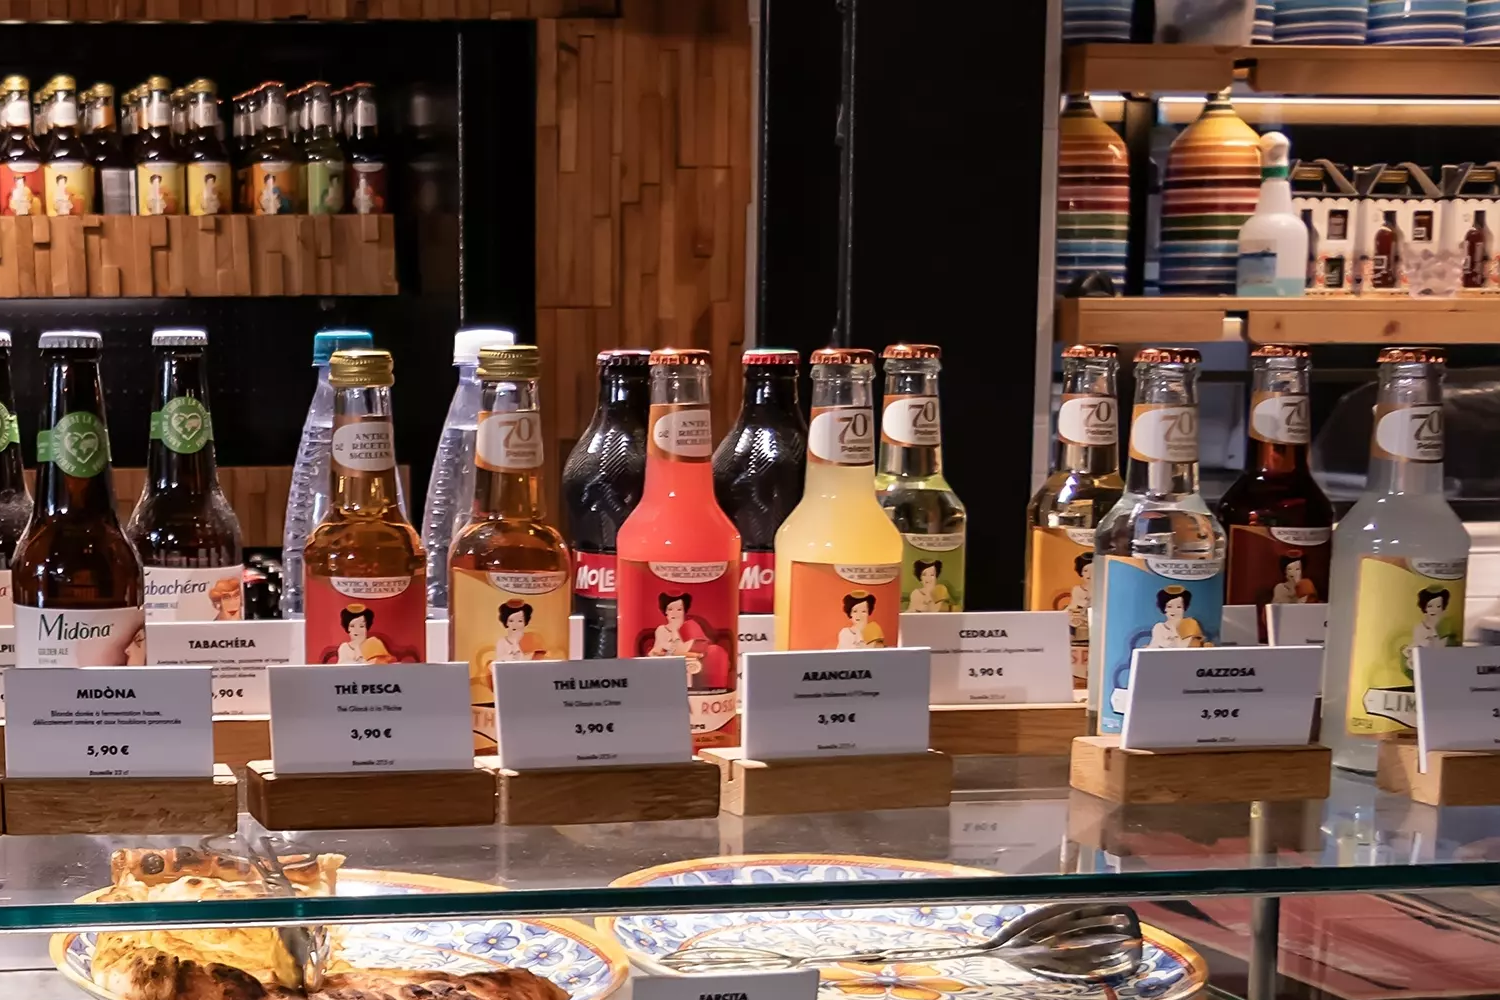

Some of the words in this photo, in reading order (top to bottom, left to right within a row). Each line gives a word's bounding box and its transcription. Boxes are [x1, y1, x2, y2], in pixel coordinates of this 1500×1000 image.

[144, 567, 207, 595] abachéra
[576, 565, 615, 592] MOLE
[739, 565, 774, 589] MO
[38, 613, 112, 641] Midòna
[959, 629, 1008, 639] CEDRATA
[189, 637, 255, 649] TABACHÉRA
[802, 670, 872, 681] ARANCIATA
[1196, 668, 1256, 678] GAZZOSA
[335, 682, 359, 694] THÈ
[362, 684, 401, 694] PESCA
[579, 678, 628, 689] LIMONE
[77, 686, 136, 699] MIDÒNA
[212, 689, 233, 699] ,90
